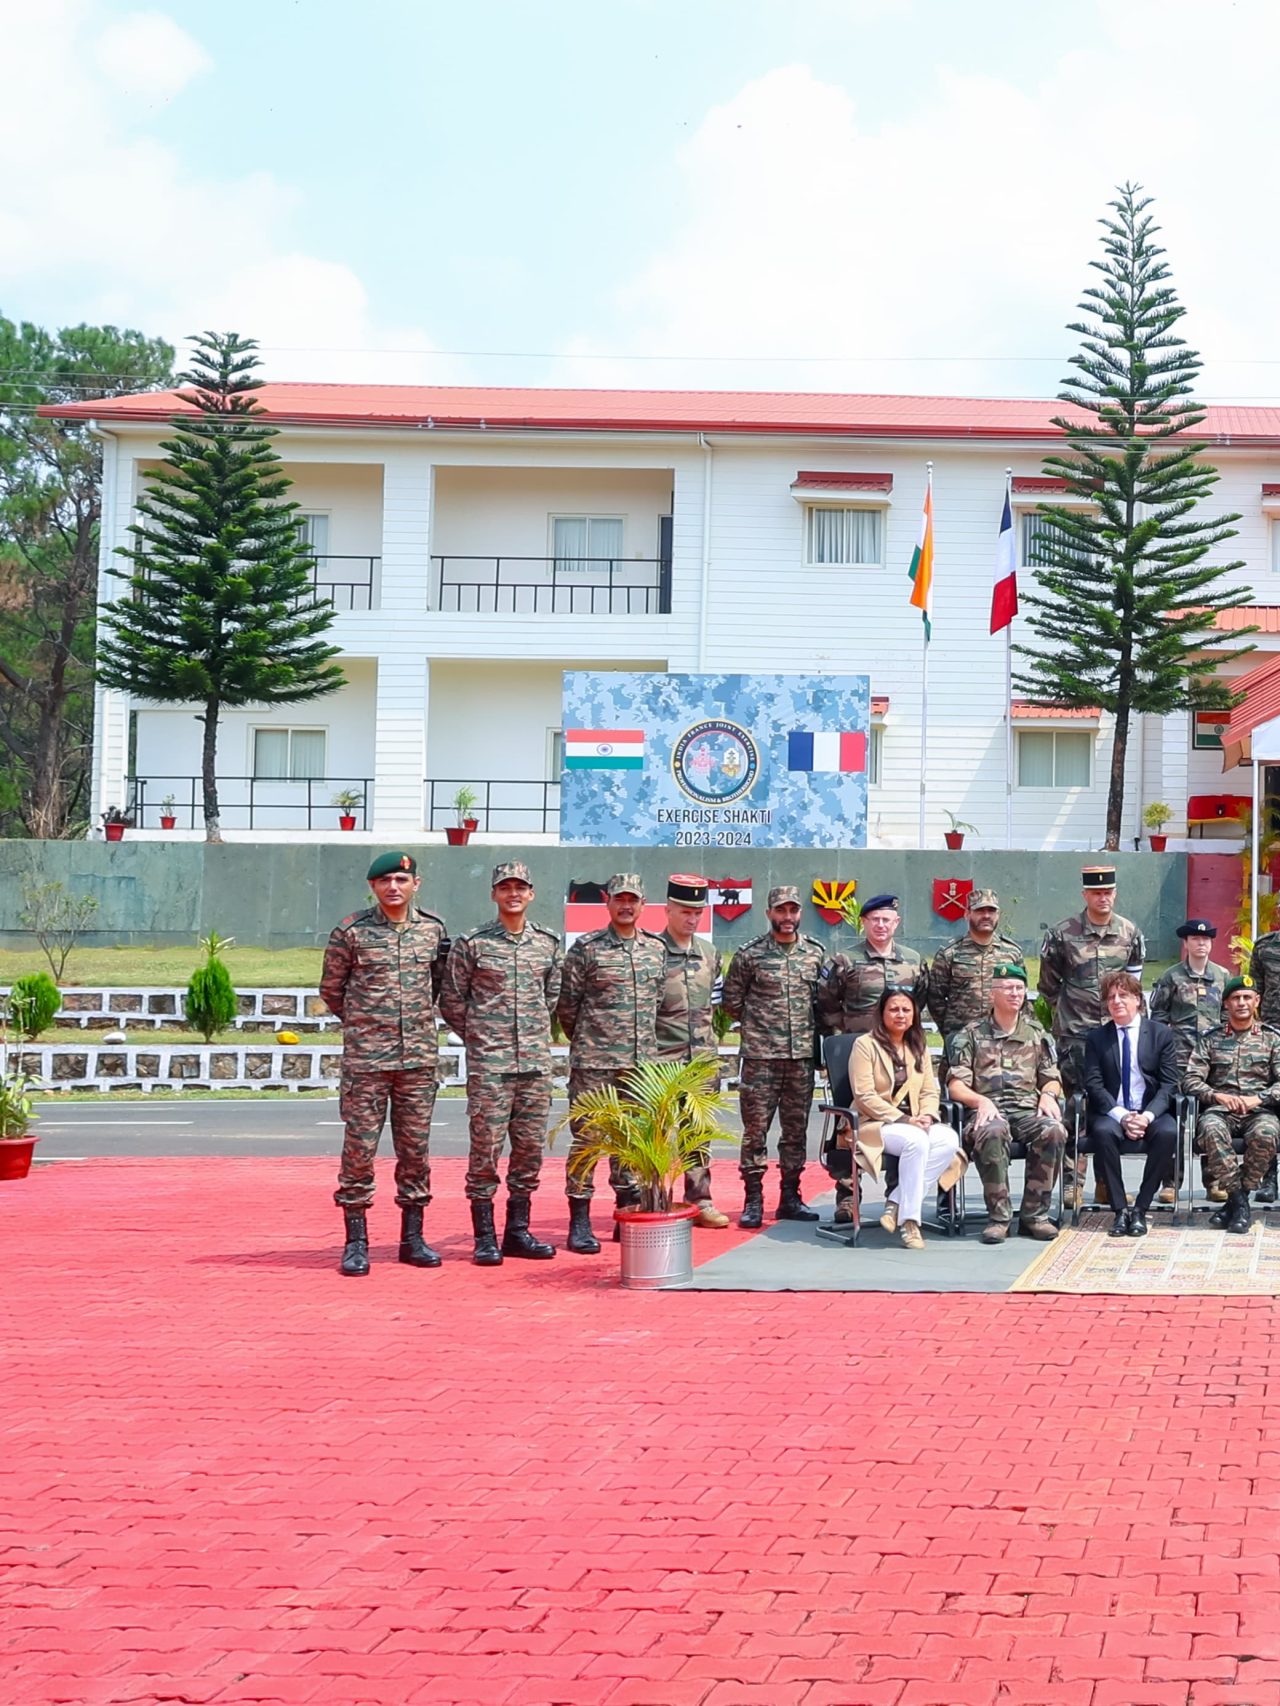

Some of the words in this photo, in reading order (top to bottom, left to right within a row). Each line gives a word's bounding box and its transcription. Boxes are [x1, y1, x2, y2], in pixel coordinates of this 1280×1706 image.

[715, 722, 736, 732] JOINT
[657, 808, 719, 824] EXERCISE
[723, 809, 771, 824] SHAKTI
[675, 831, 752, 846] 2023-2024
